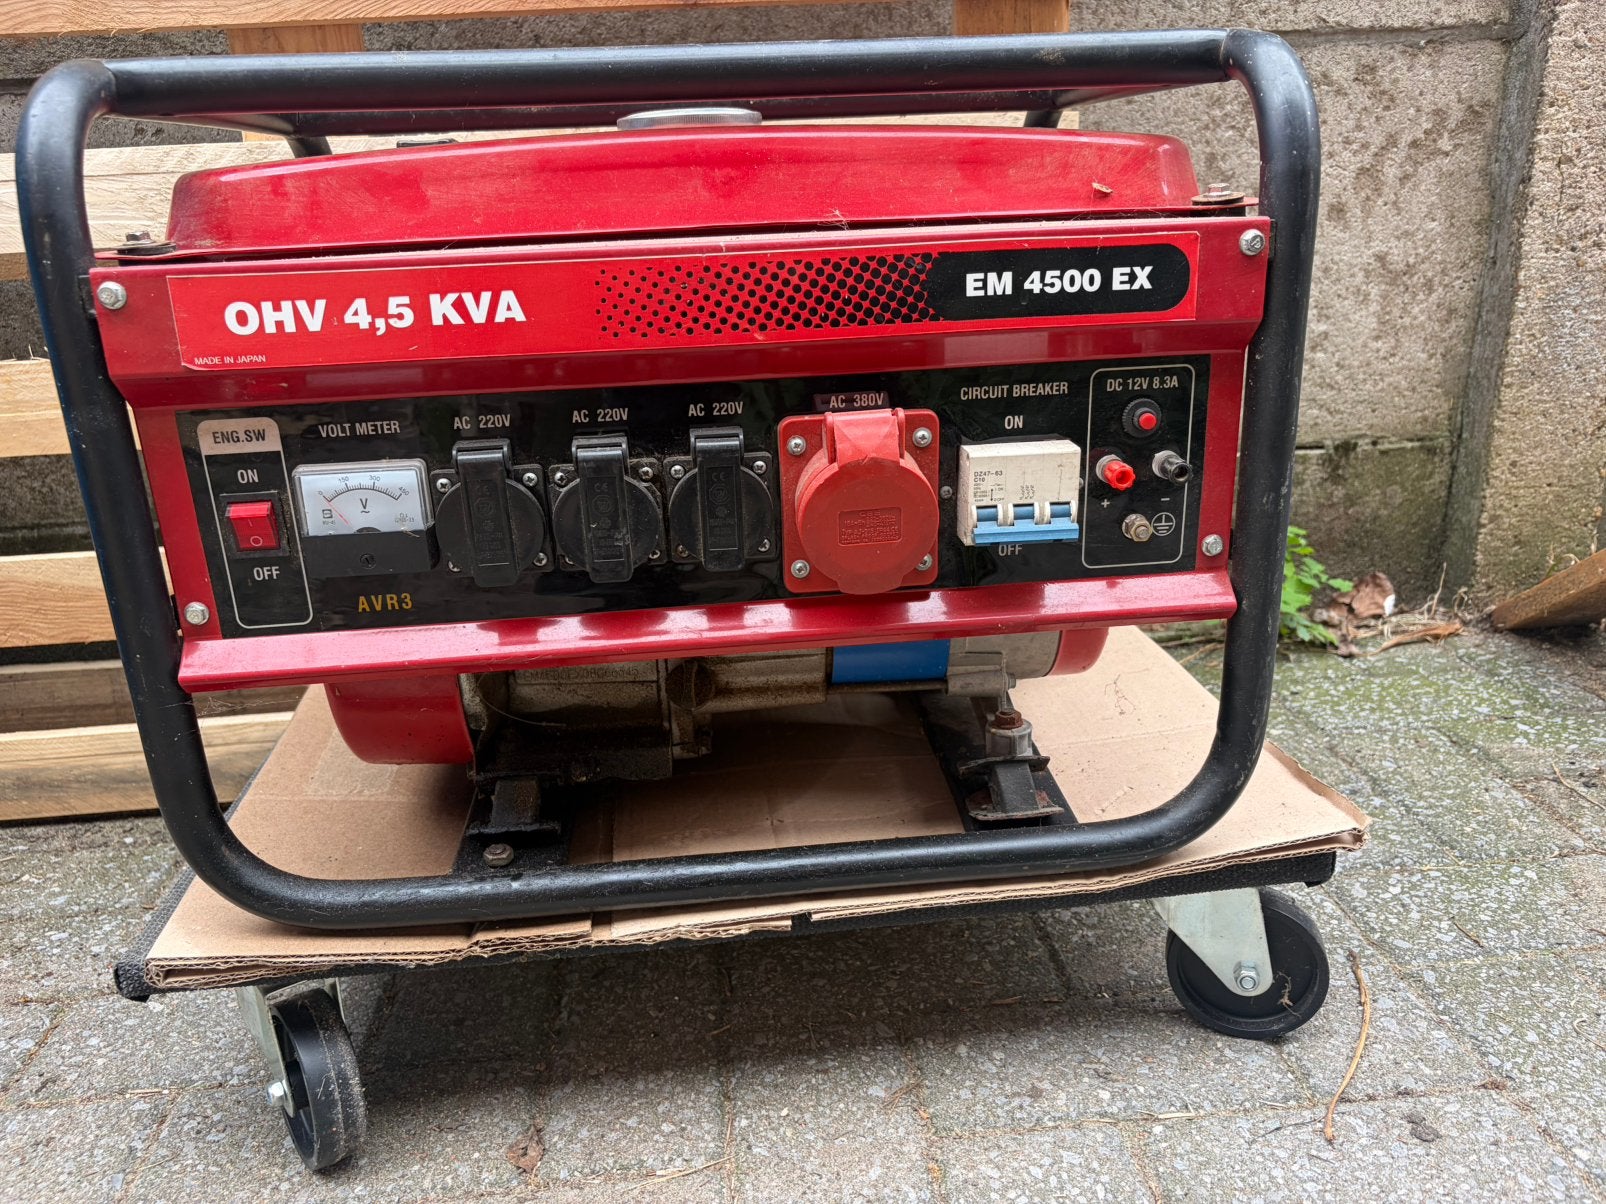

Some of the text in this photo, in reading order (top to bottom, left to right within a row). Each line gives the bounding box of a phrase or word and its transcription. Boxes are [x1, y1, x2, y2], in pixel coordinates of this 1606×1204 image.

[965, 265, 1154, 298] EM 4500 EX
[223, 289, 527, 337] OHV 4,5 KVA
[194, 354, 267, 366] MADE IN JAPAN
[960, 381, 1069, 401] CIRCUIT BREAKER
[1106, 375, 1179, 392] DC 12V 8.3A
[829, 393, 885, 409] AC 380V
[572, 407, 629, 424] AC 220V
[688, 401, 744, 418] AC 220V
[318, 420, 401, 439] VOLT METER
[453, 414, 512, 430] AC 220V
[1003, 415, 1024, 430] ON
[211, 428, 267, 445] ENG.SW
[236, 468, 259, 484] ON
[337, 475, 350, 484] 150
[368, 474, 381, 482] 300
[397, 486, 411, 497] 450
[359, 497, 369, 509] V
[998, 544, 1023, 557] OFF
[252, 566, 281, 581] OFF
[357, 593, 414, 613] AVR3
